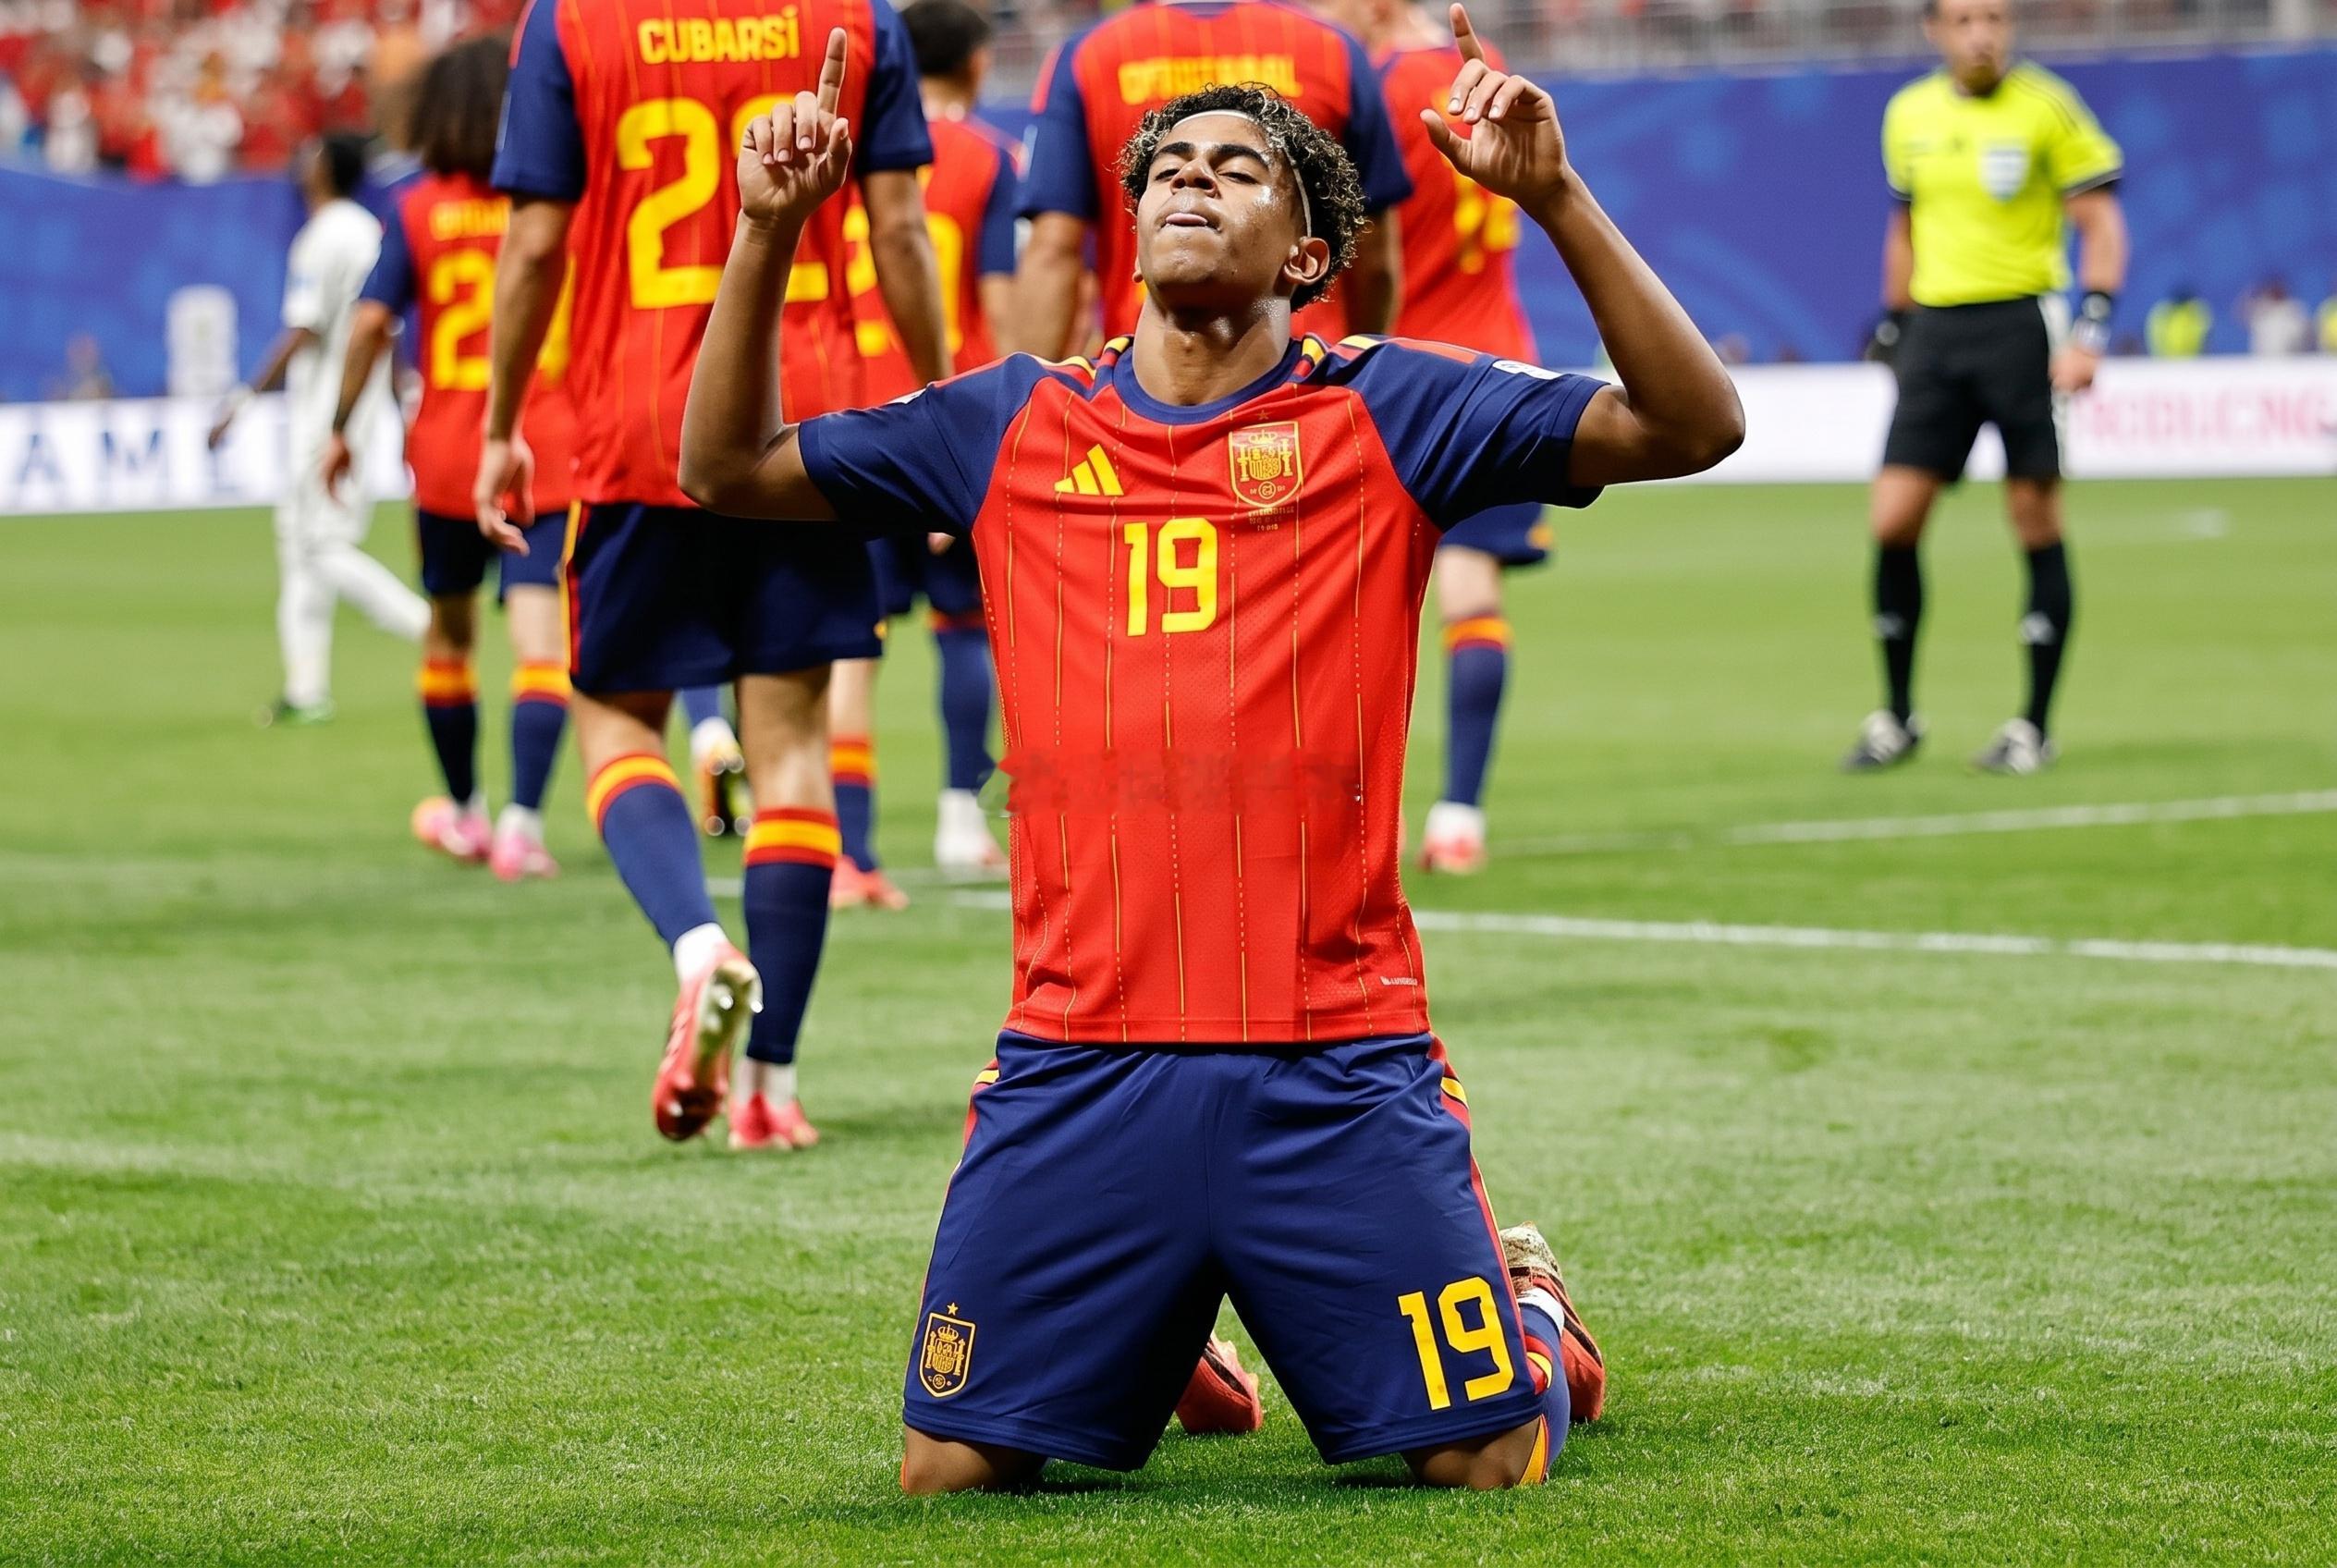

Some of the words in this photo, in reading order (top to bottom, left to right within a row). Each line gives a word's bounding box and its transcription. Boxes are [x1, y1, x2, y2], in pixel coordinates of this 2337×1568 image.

[638, 5, 801, 64] CUBARSÍ
[1123, 517, 1217, 637] 19
[1398, 1276, 1515, 1411] 19
